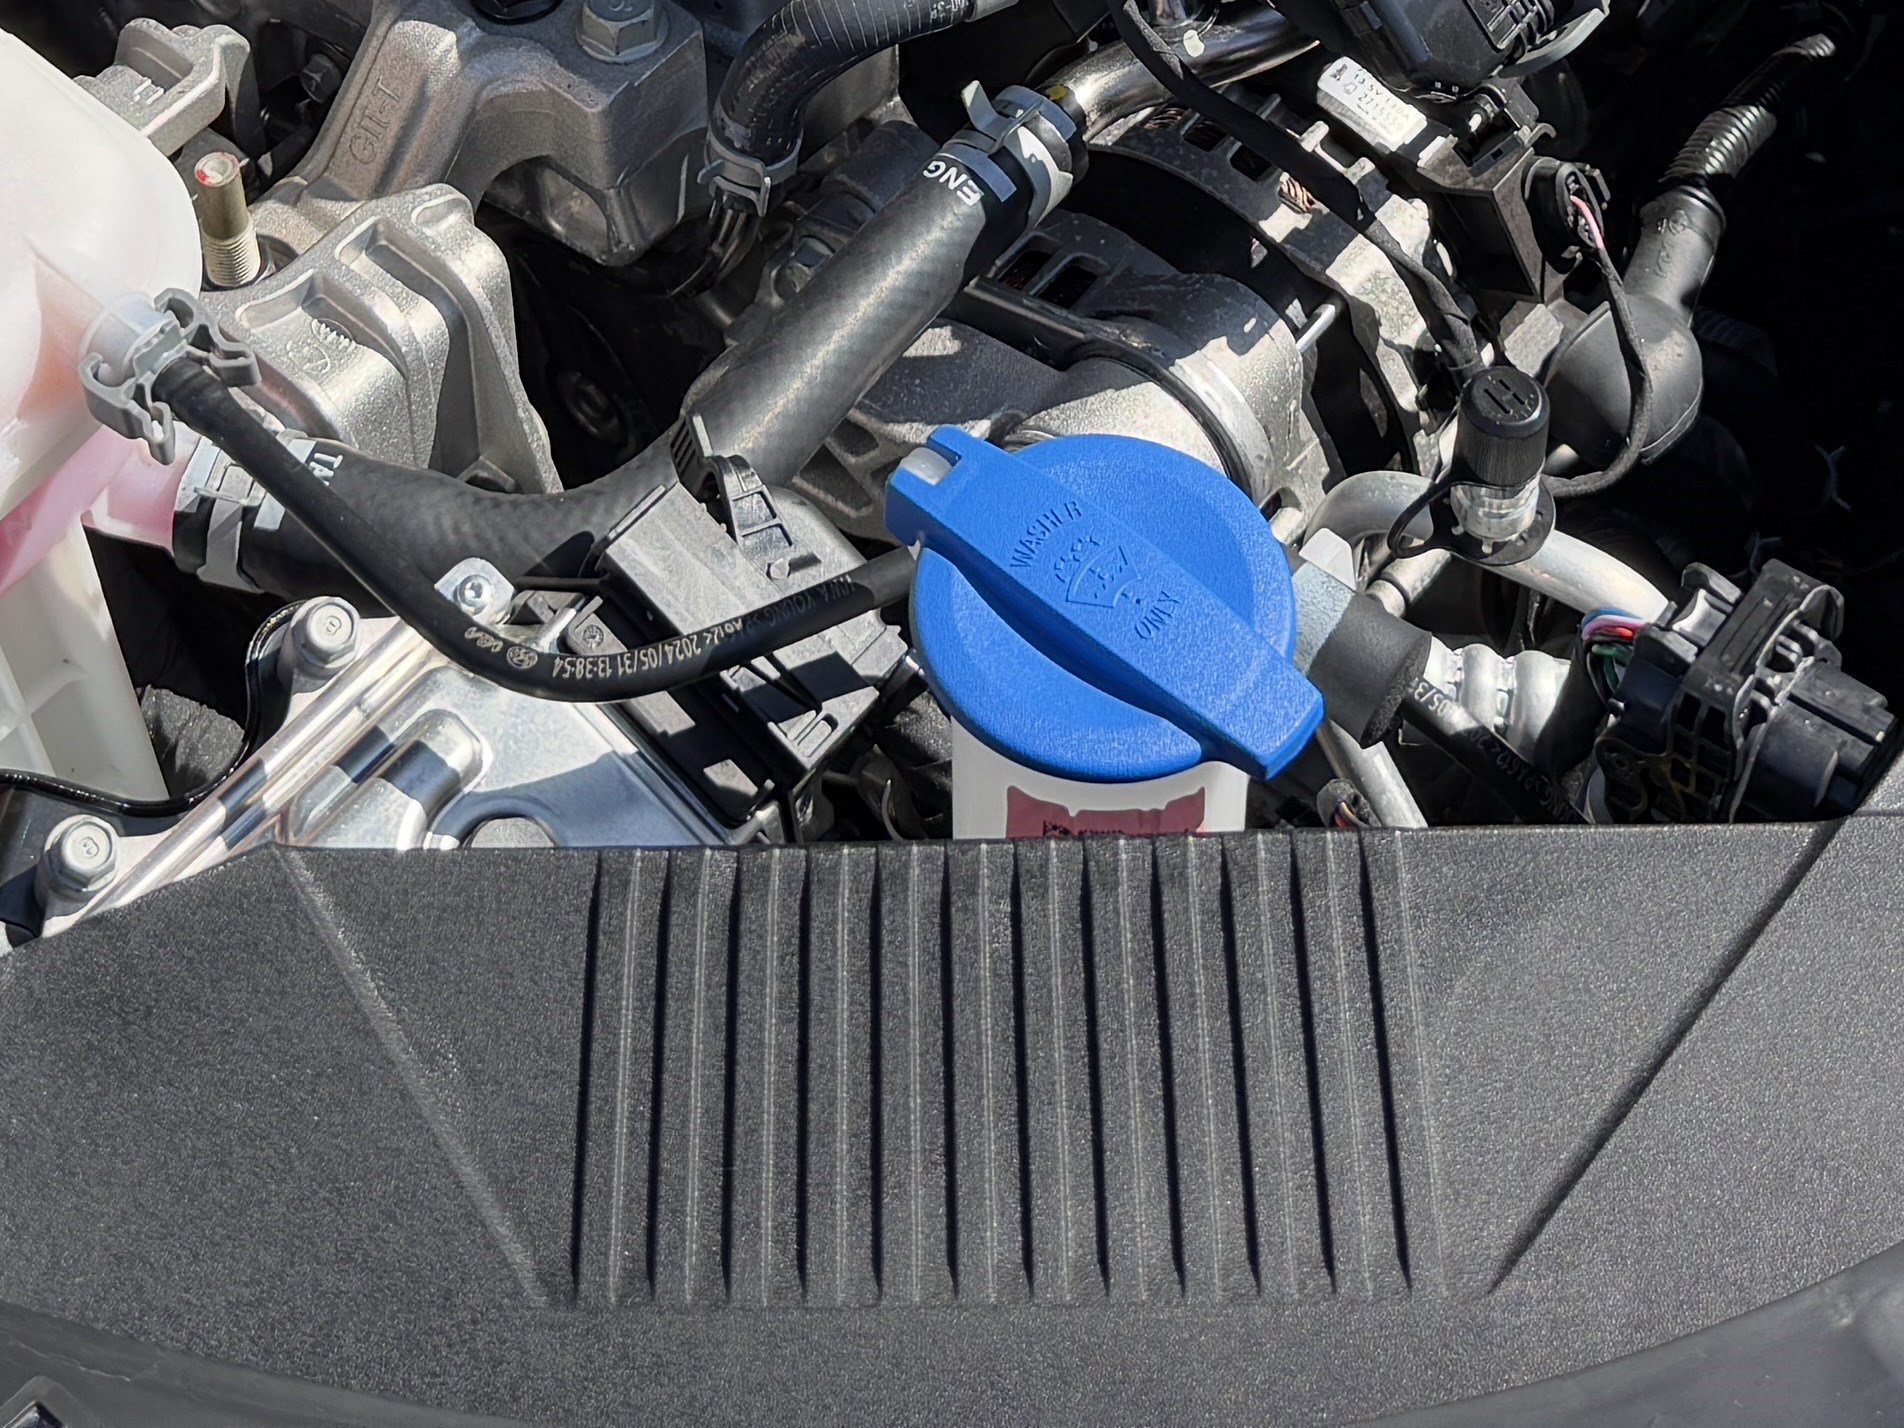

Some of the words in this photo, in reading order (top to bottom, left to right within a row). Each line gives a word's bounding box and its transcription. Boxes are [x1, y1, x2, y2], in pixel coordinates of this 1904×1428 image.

[920, 159, 985, 208] ENG
[552, 655, 612, 680] 13:38:54
[617, 636, 702, 675] 2024/05/31
